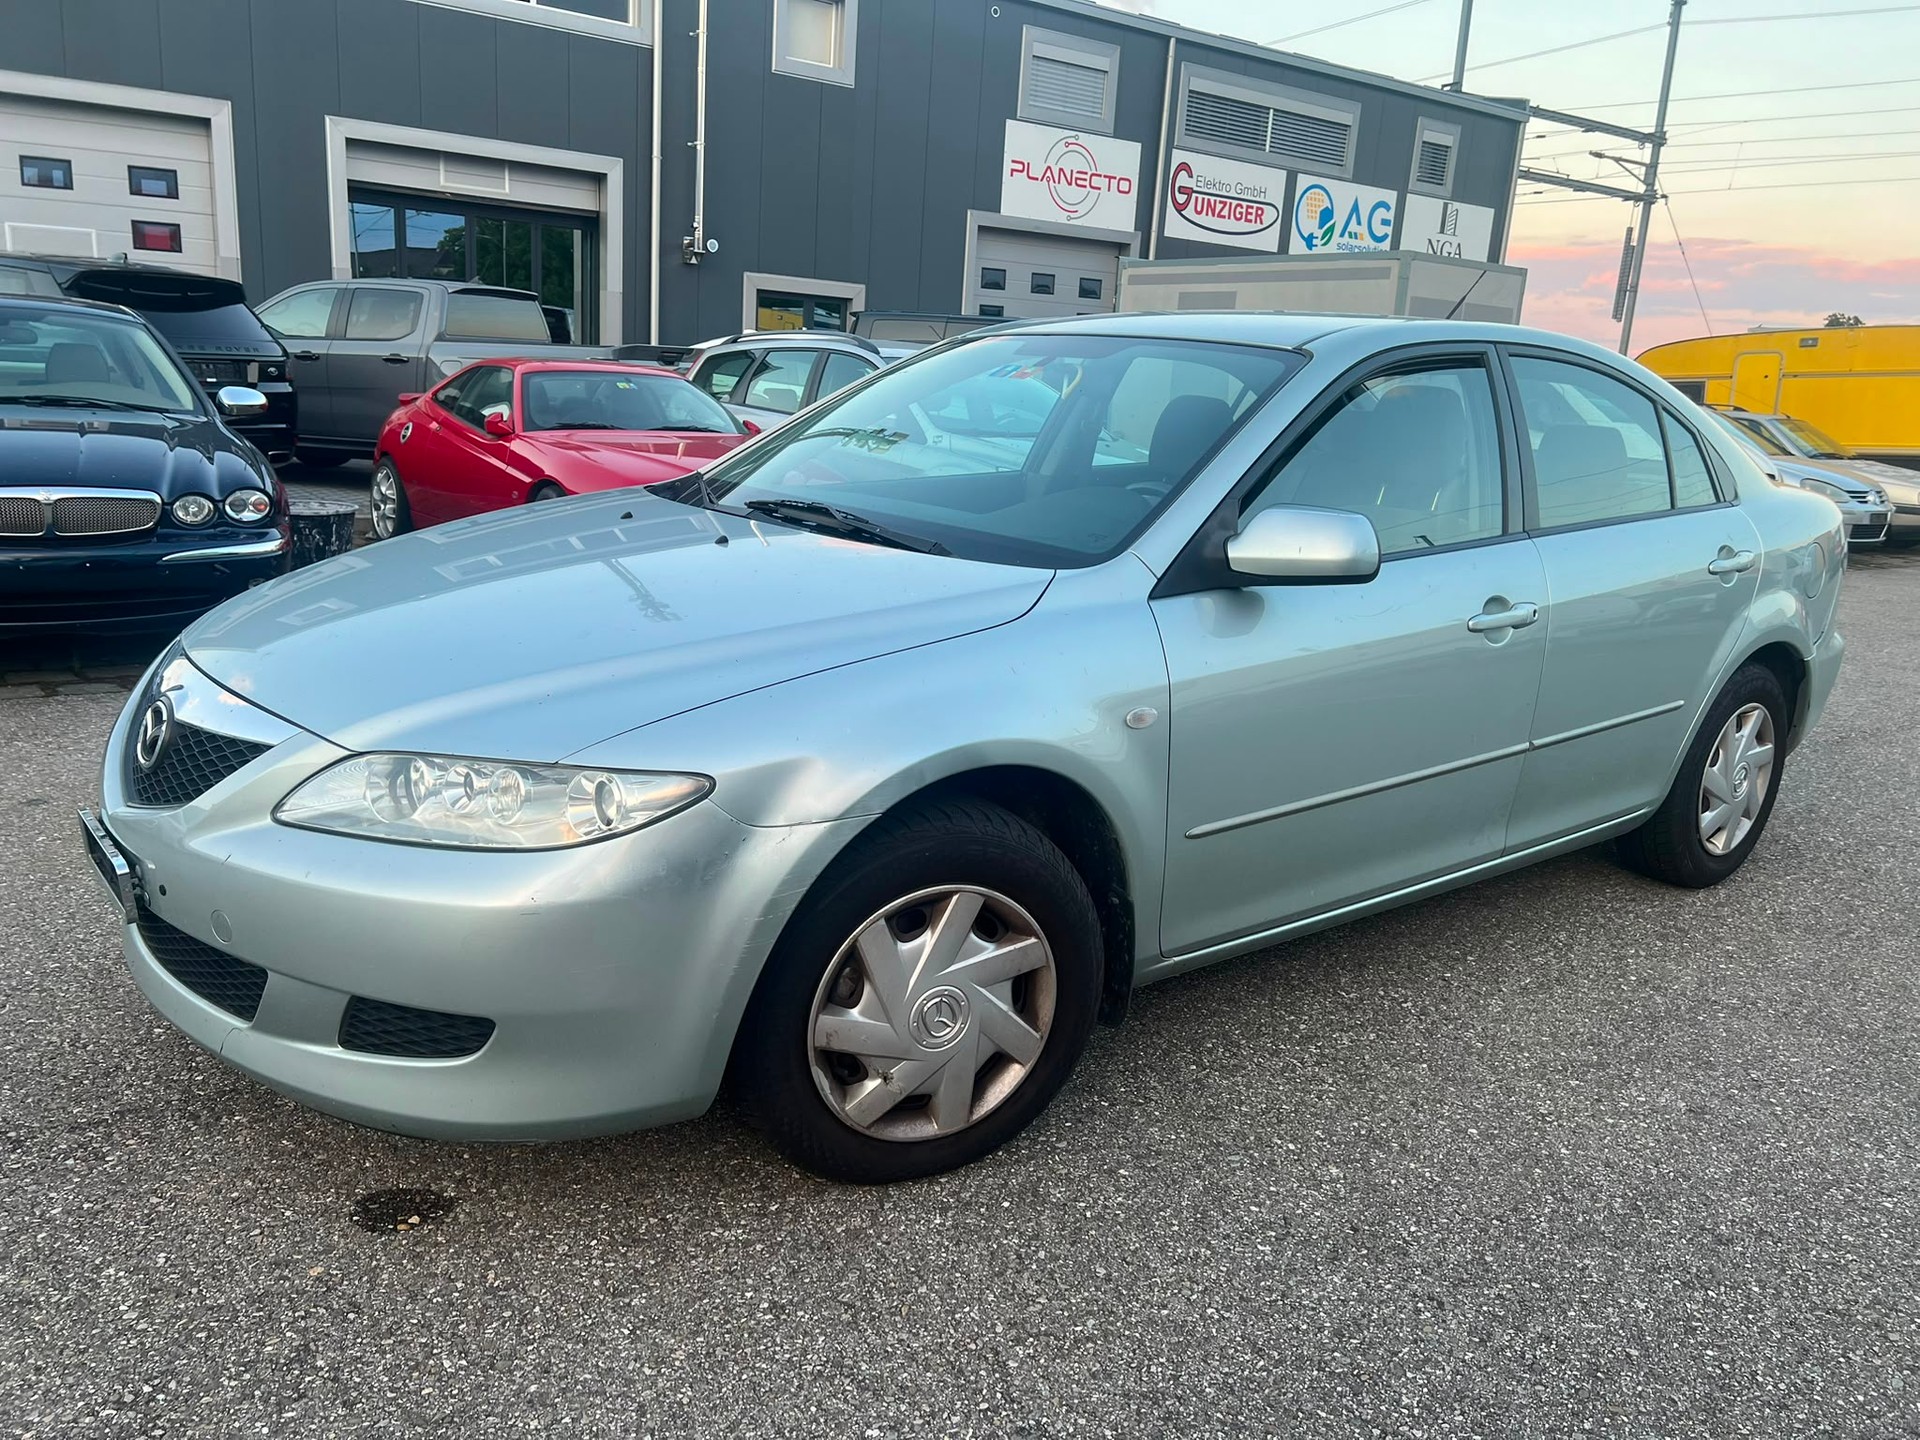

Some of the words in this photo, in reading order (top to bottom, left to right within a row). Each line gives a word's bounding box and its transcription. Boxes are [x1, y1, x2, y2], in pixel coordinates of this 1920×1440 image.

[1010, 159, 1132, 196] PLANECTO
[1195, 175, 1232, 193] Elektro
[1234, 182, 1268, 199] GmbH
[1339, 196, 1392, 244] AG
[1426, 238, 1462, 259] NGA
